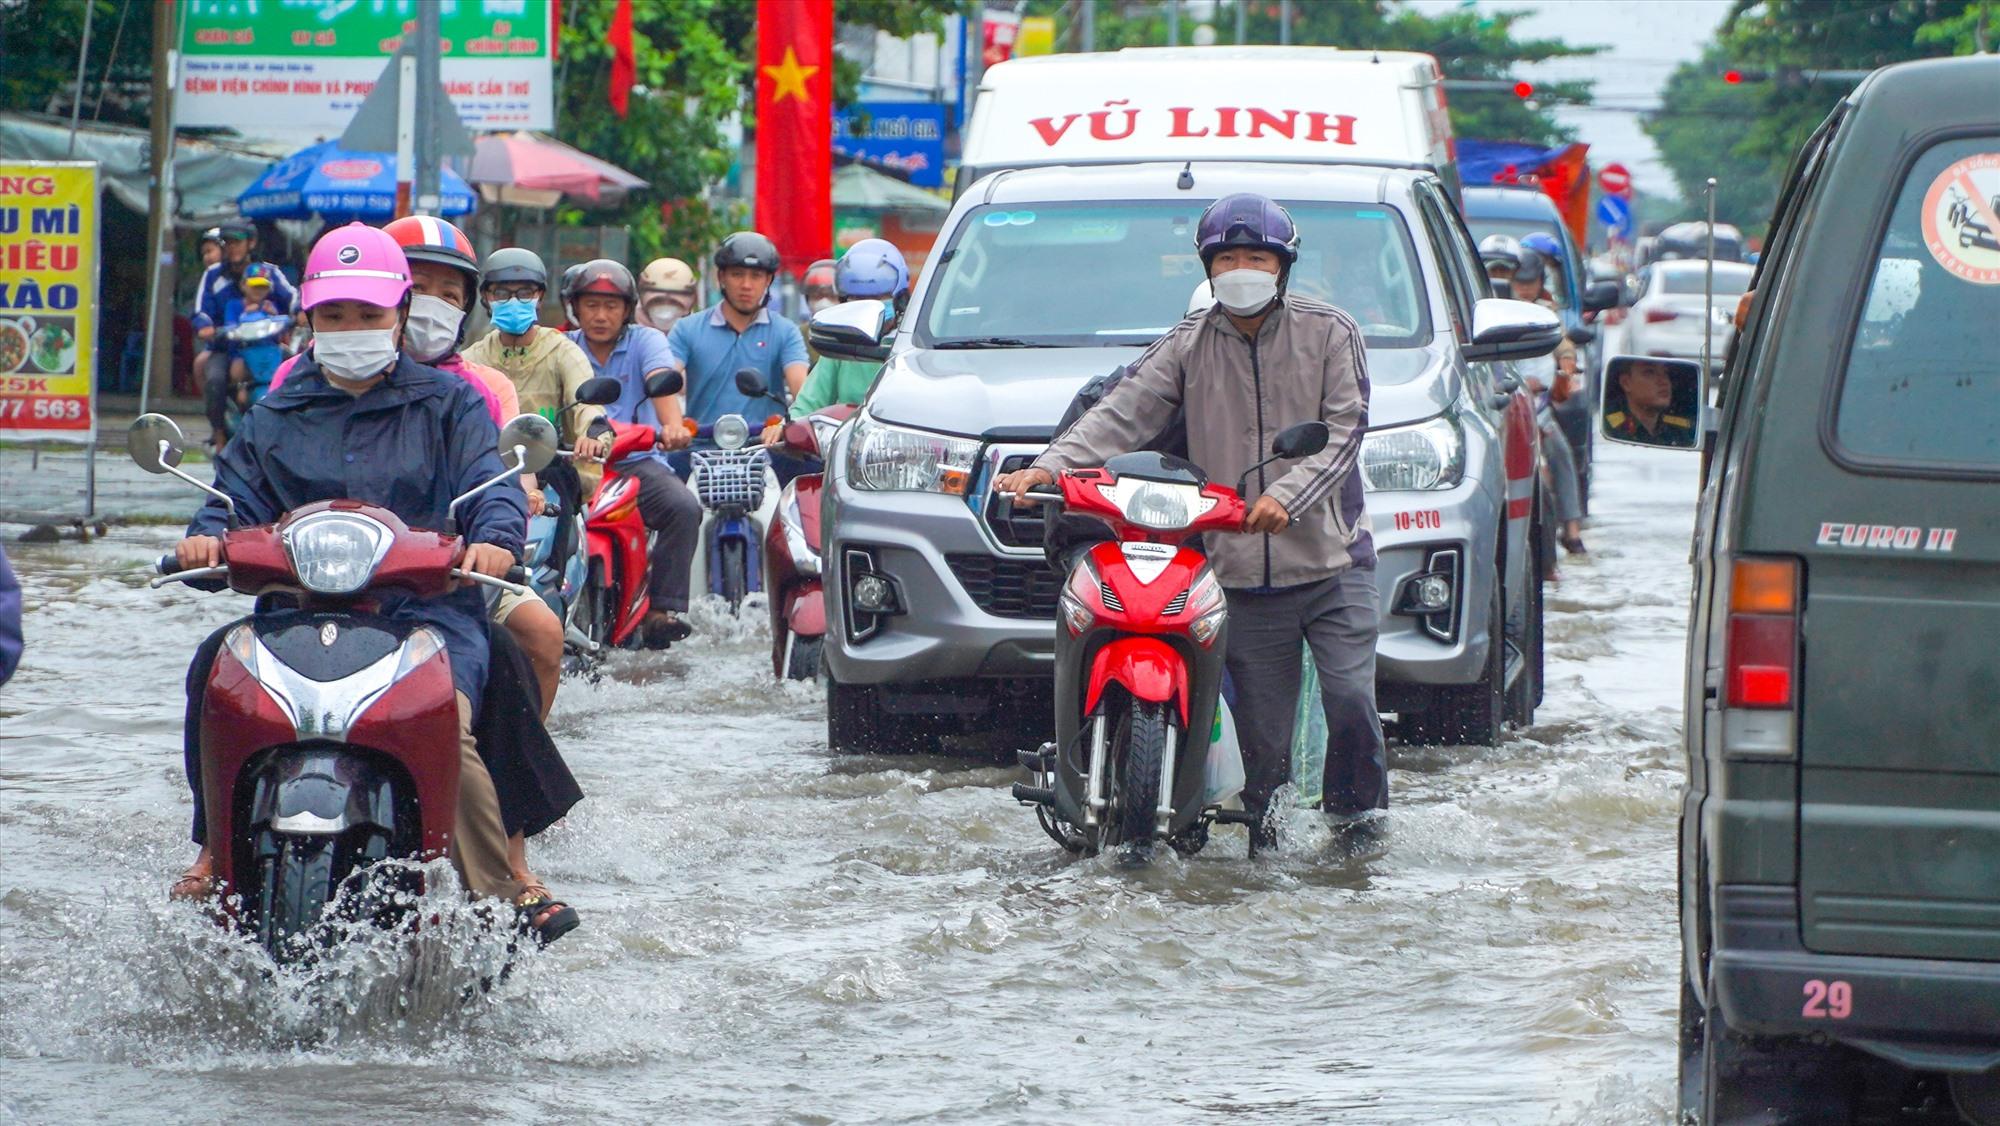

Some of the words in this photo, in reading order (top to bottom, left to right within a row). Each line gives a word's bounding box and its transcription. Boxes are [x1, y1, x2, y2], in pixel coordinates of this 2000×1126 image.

[185, 77, 218, 95] BỆNH
[221, 77, 248, 95] VIỆN
[1027, 99, 1141, 147] VŨ
[1167, 106, 1358, 146] LINH
[32, 203, 79, 234] MÌ
[34, 399, 80, 419] 563
[1816, 522, 1921, 550] EURO
[1924, 527, 1956, 551] II
[1802, 979, 1852, 1019] 29
